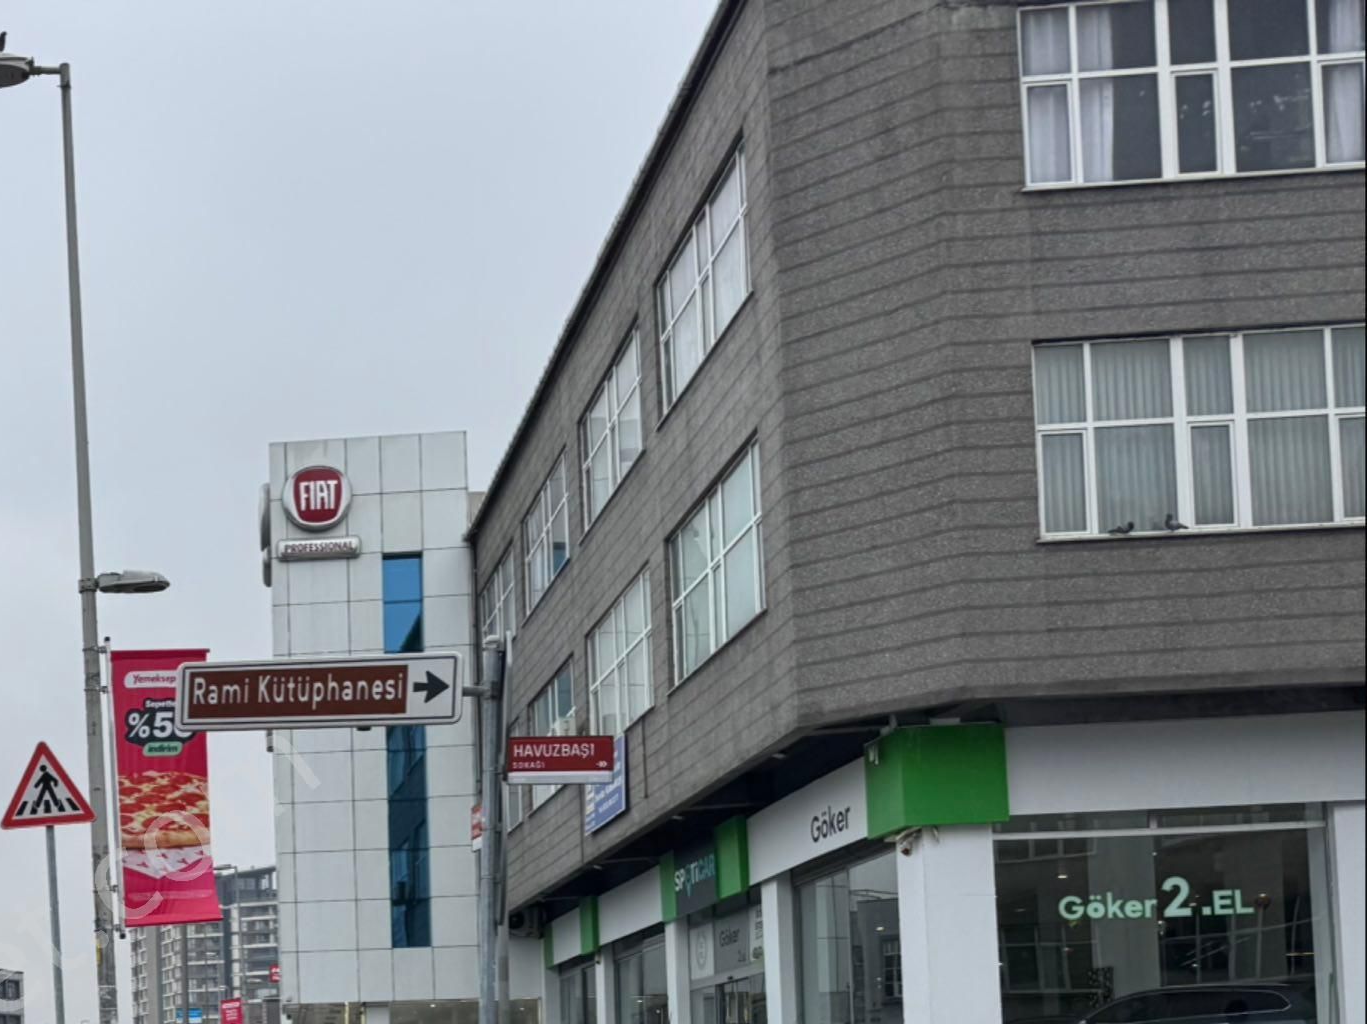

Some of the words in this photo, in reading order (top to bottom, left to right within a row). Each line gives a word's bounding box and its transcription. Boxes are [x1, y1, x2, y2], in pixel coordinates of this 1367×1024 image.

[299, 480, 338, 511] FIAT
[284, 541, 354, 554] PROFESSIONAL
[193, 677, 250, 704] Rami
[258, 673, 403, 710] Kütüphanesi
[128, 711, 193, 738] %5
[514, 743, 595, 758] HAVUZBAŞI
[810, 806, 851, 843] Göker
[1058, 892, 1157, 919] Göker
